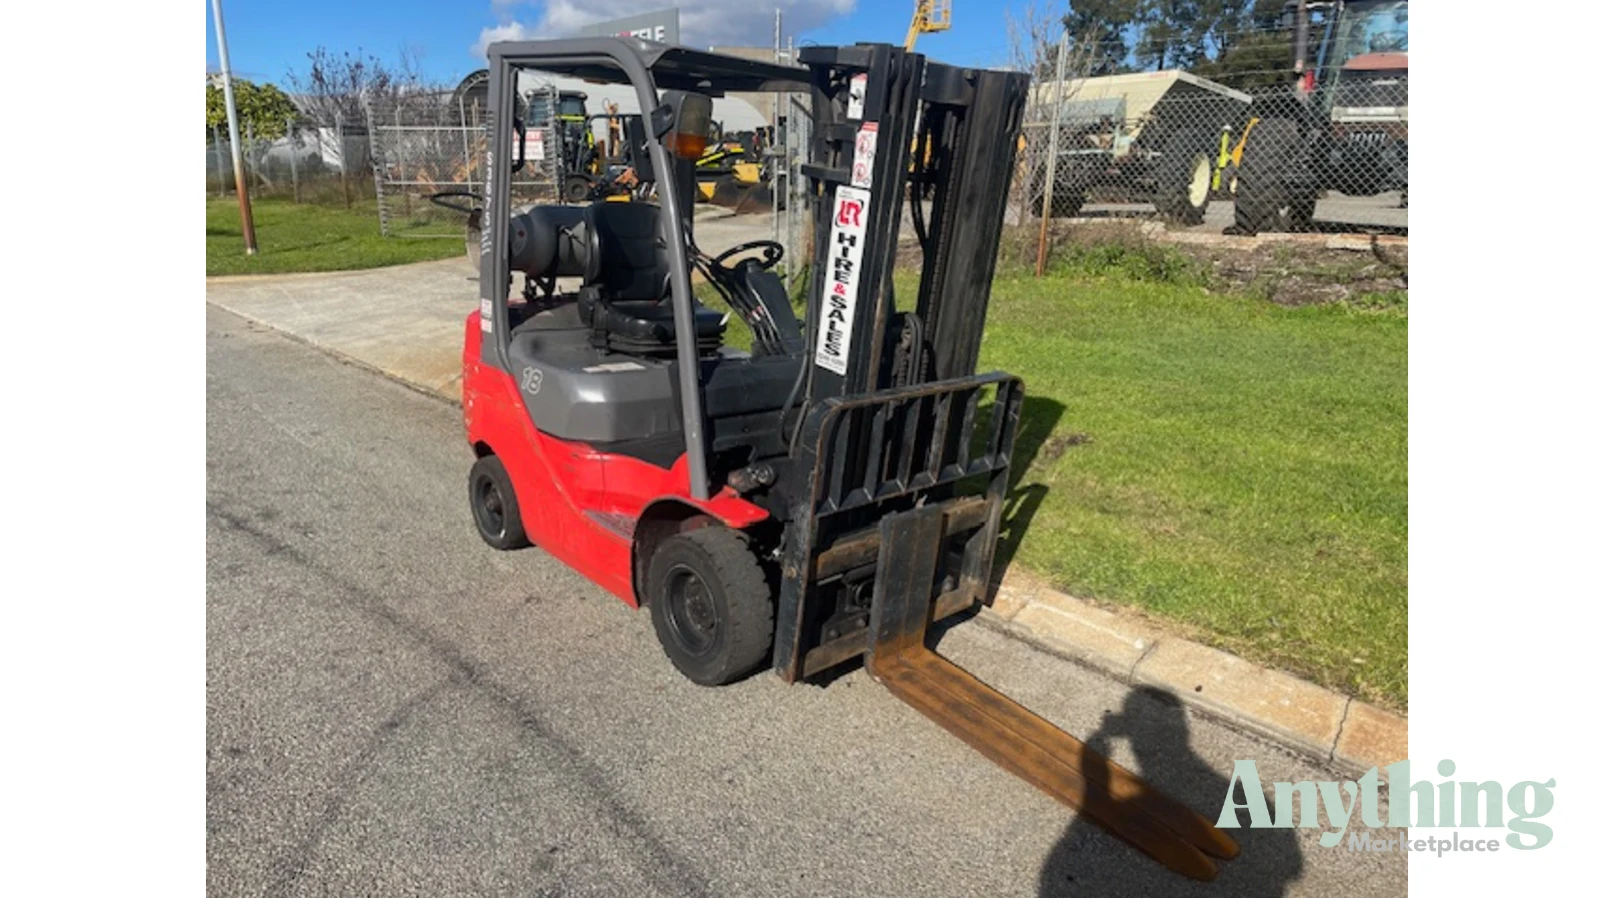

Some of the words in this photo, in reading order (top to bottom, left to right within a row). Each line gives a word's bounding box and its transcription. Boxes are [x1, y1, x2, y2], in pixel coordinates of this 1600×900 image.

[834, 231, 857, 285] HIRE
[823, 295, 848, 358] SALES
[520, 366, 544, 395] 18
